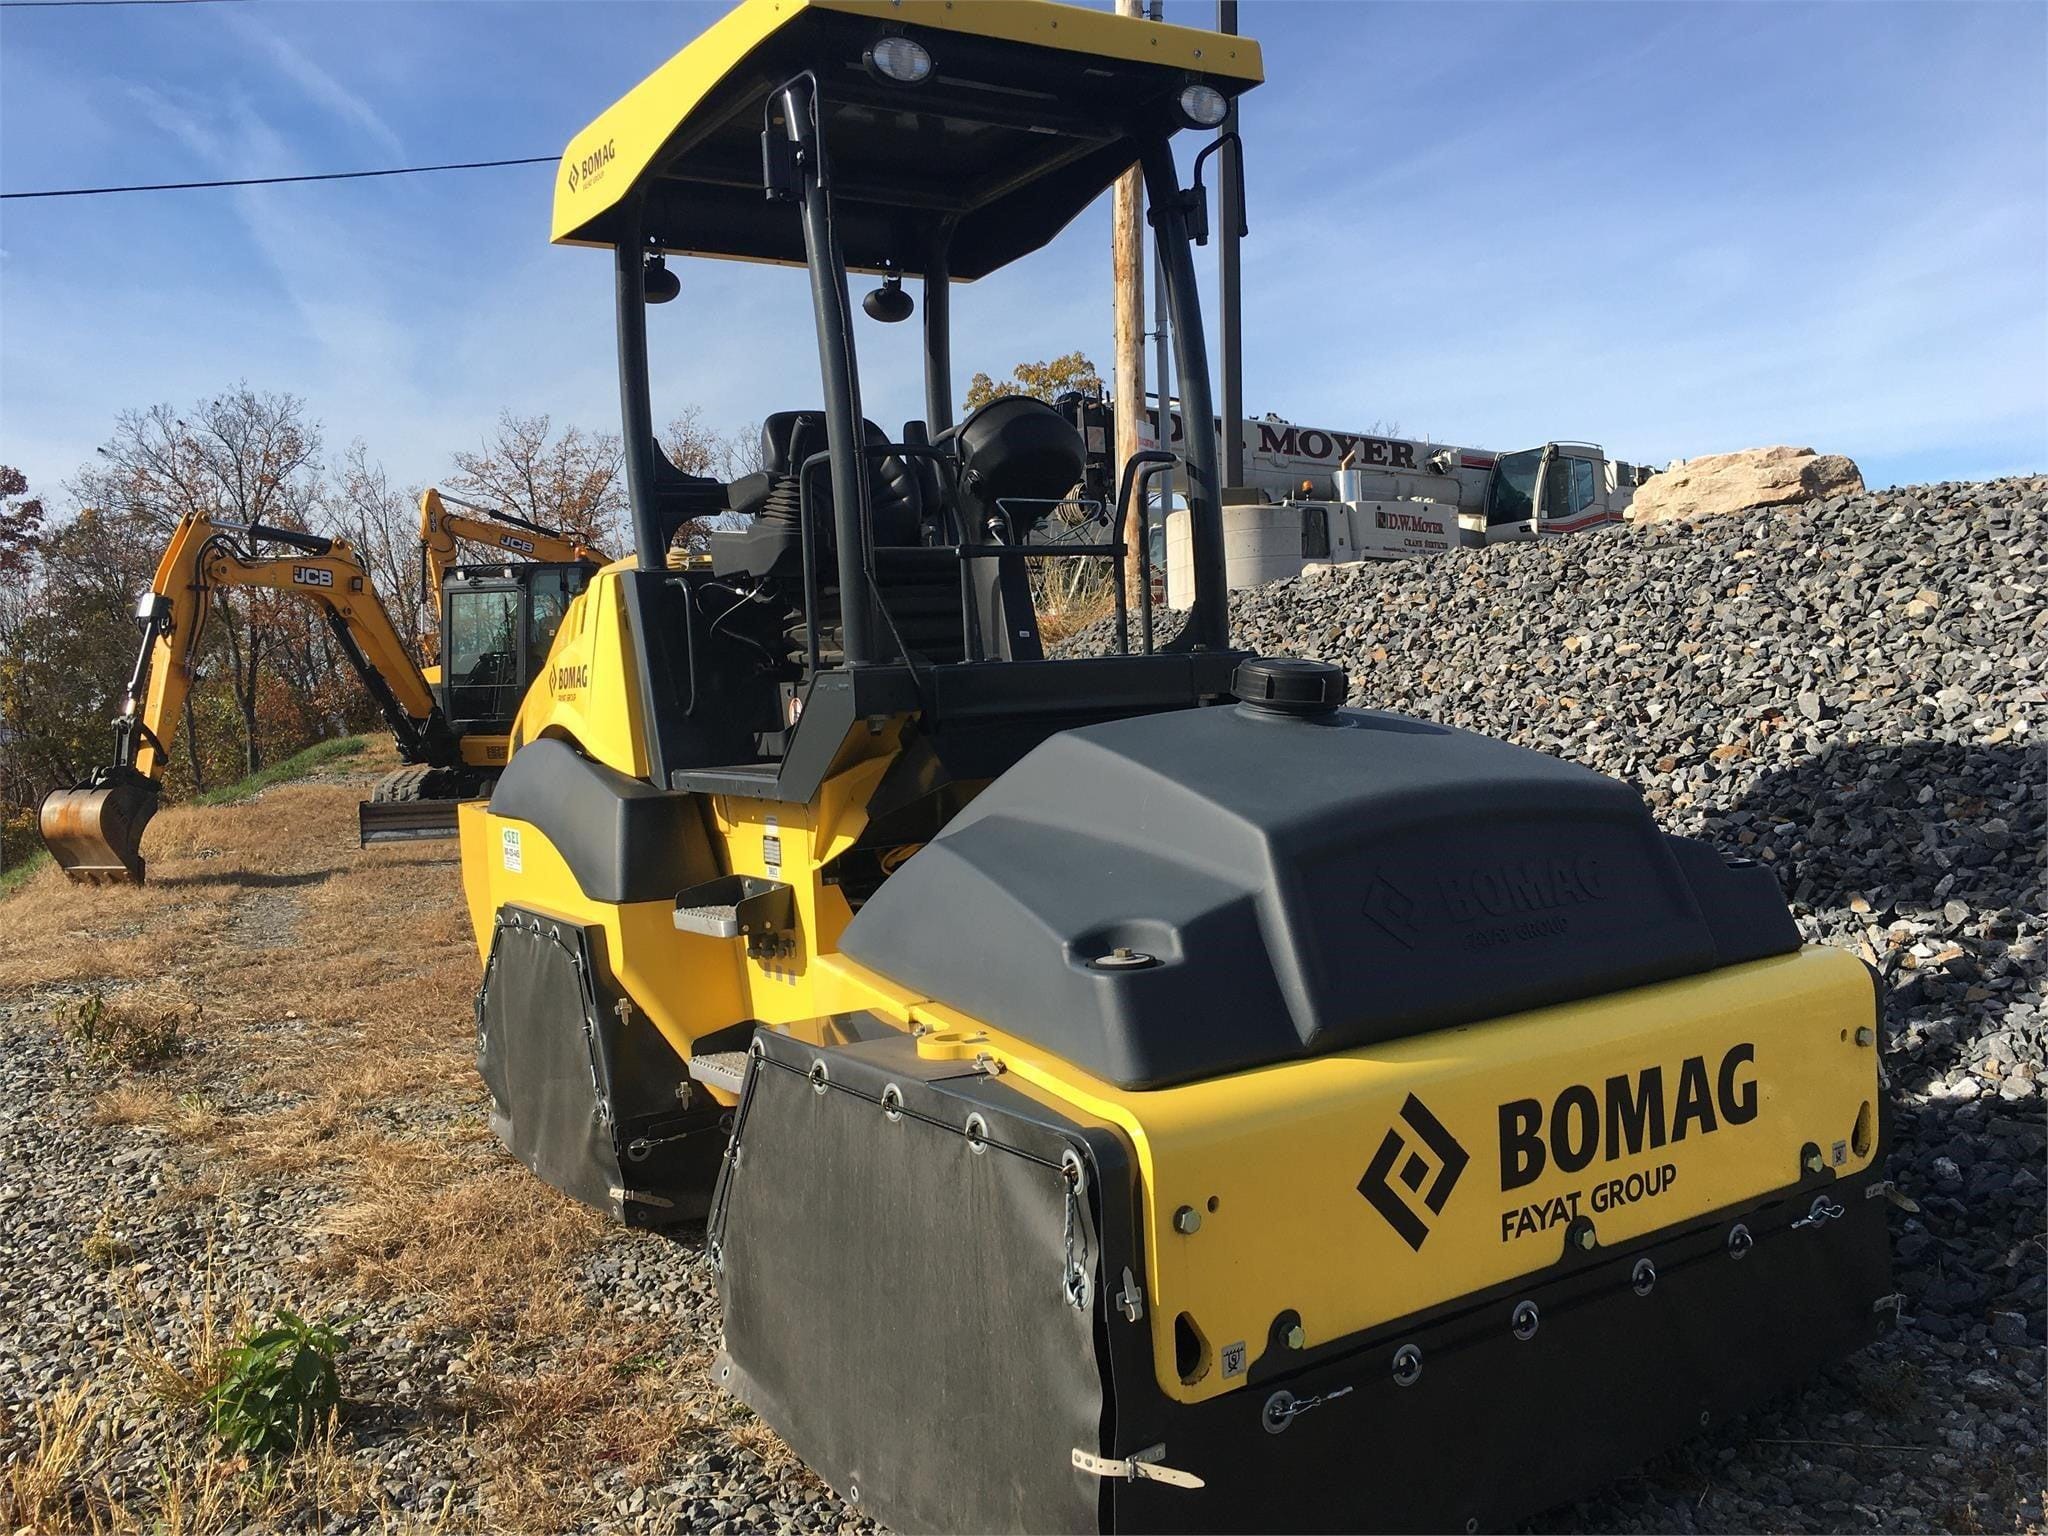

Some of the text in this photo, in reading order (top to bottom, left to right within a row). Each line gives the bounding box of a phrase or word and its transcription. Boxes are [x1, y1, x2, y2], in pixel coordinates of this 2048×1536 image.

[582, 138, 615, 180] BOMAG
[1257, 423, 1417, 470] MOYER
[500, 536, 534, 553] JCB
[293, 566, 333, 586] JCB
[558, 664, 588, 691] BOMAG
[1498, 1043, 1758, 1192] BOMAG
[1501, 1163, 1677, 1242] FAYAT GROUP
